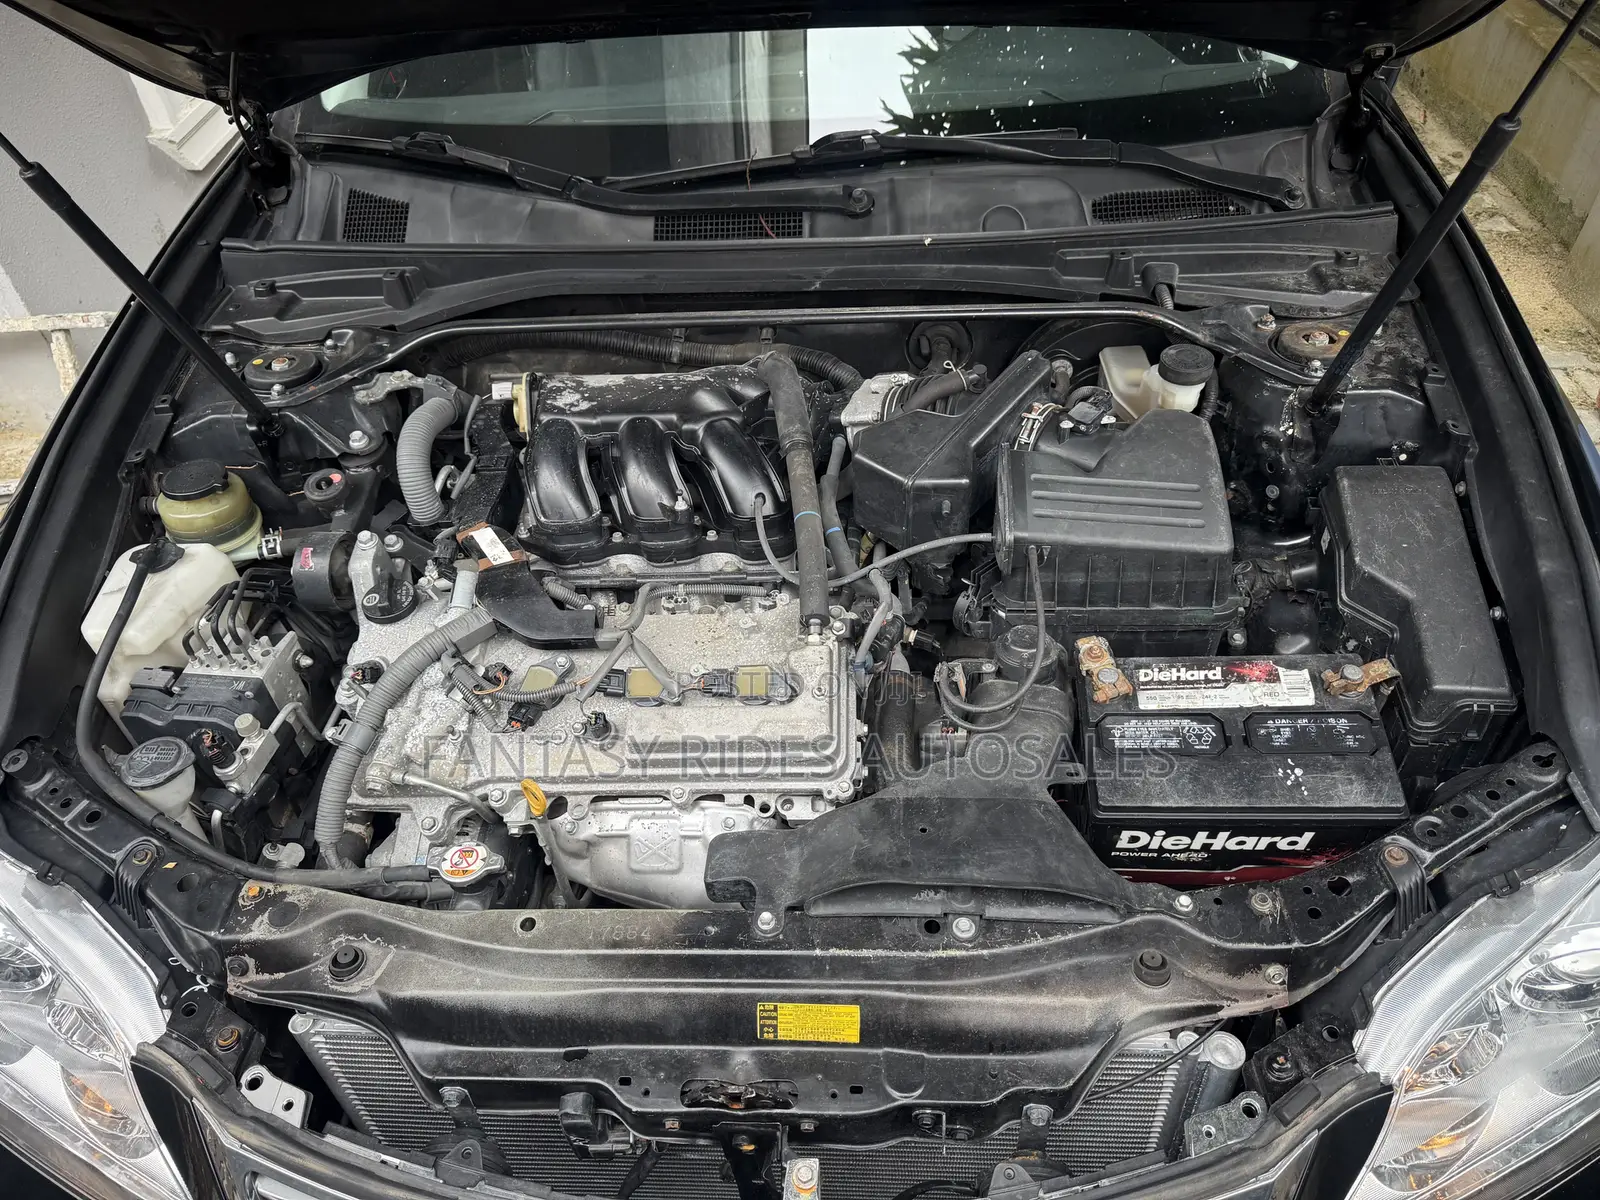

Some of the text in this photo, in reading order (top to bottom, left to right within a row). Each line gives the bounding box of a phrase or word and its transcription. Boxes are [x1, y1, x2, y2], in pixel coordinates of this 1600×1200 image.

[1138, 667, 1222, 682] DieHard
[1115, 830, 1316, 850] DieHard
[1161, 851, 1208, 860] AHEAD
